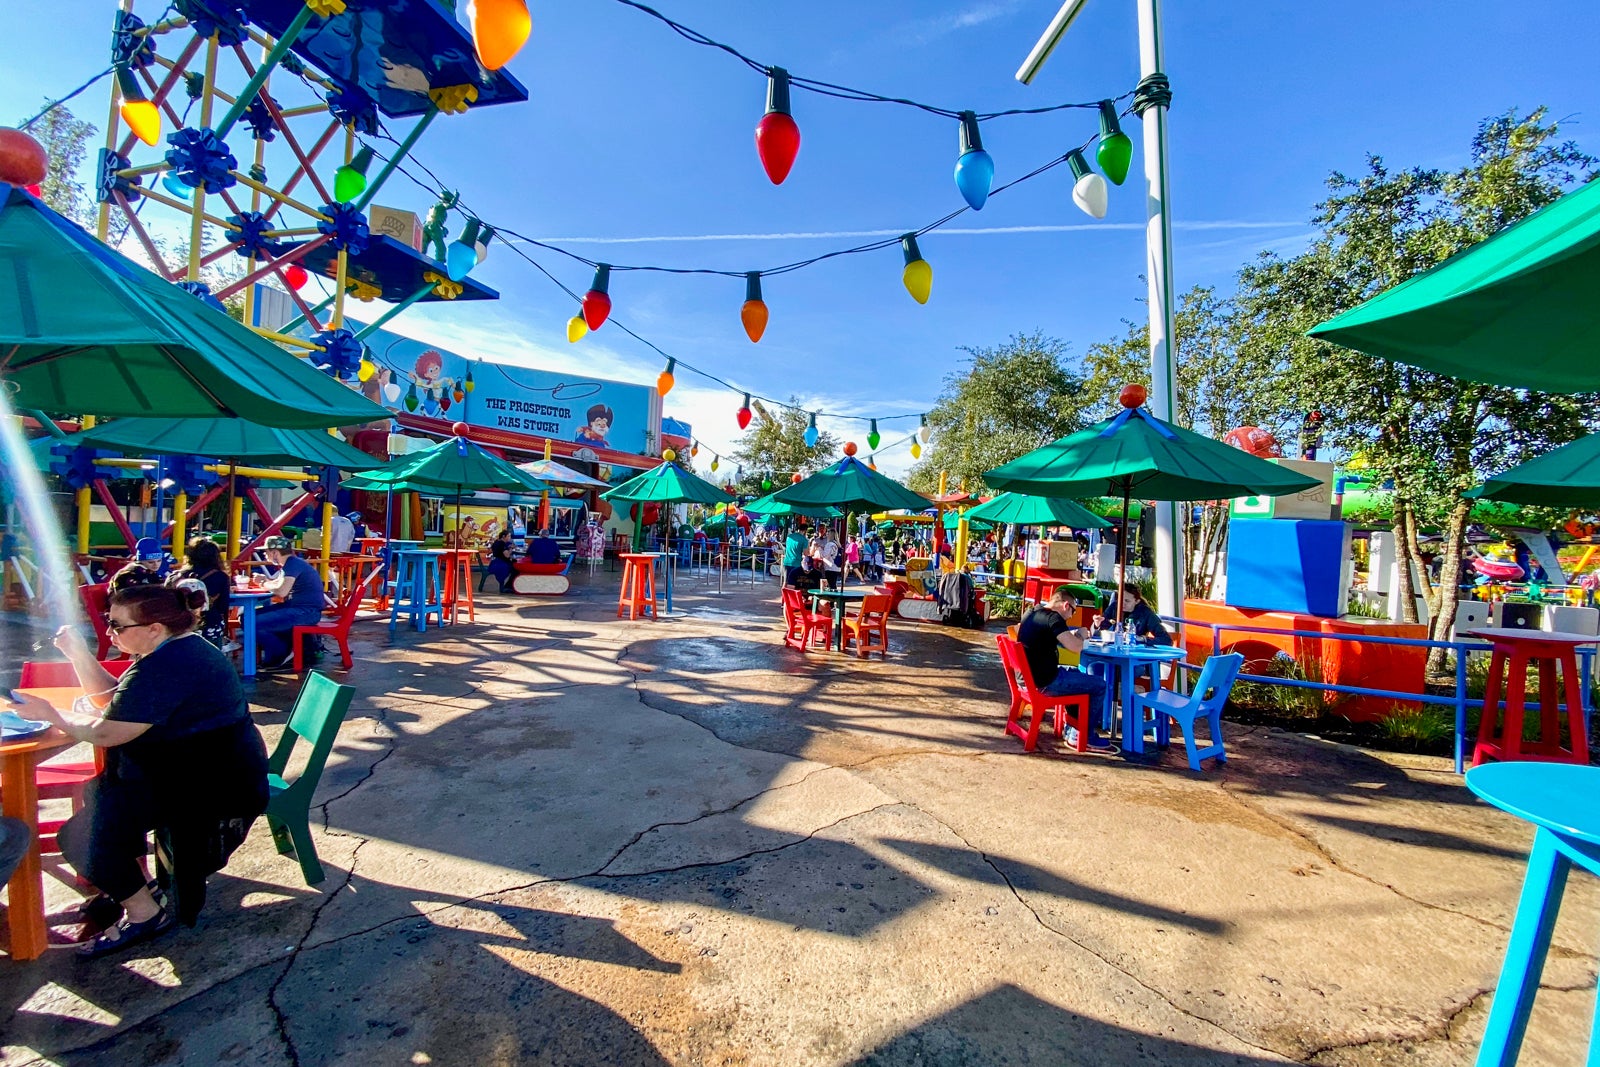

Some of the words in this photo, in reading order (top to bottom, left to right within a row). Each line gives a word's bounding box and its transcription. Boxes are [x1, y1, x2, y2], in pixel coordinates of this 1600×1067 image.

[485, 398, 506, 410] THE
[509, 400, 571, 419] PROSPECTOR
[497, 416, 521, 429] WAS
[523, 419, 560, 434] STUCK!
